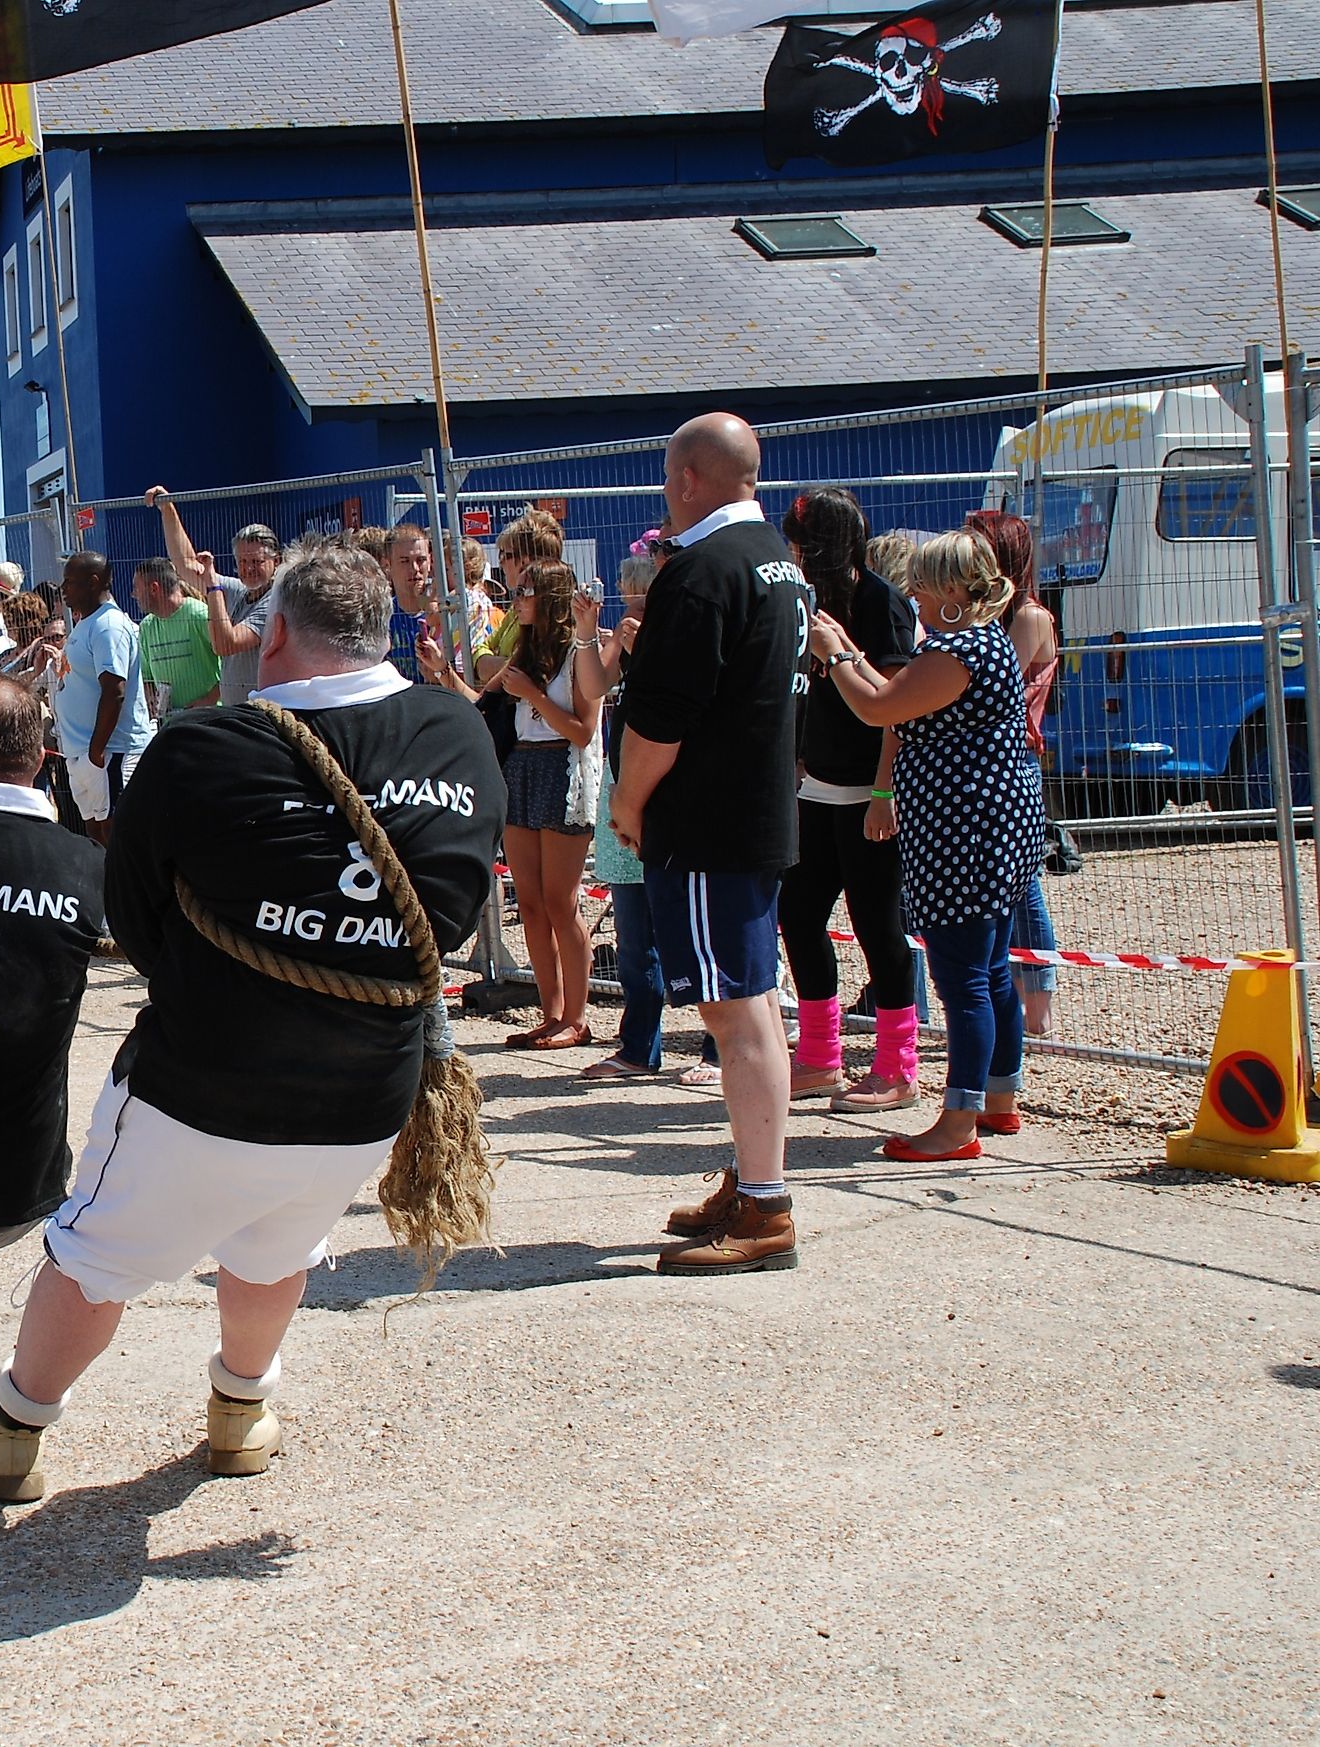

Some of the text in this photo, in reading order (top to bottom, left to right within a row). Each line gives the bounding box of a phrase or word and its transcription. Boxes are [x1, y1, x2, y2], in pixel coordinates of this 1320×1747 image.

[337, 840, 382, 902] 8
[255, 900, 412, 948] BIG DAV
